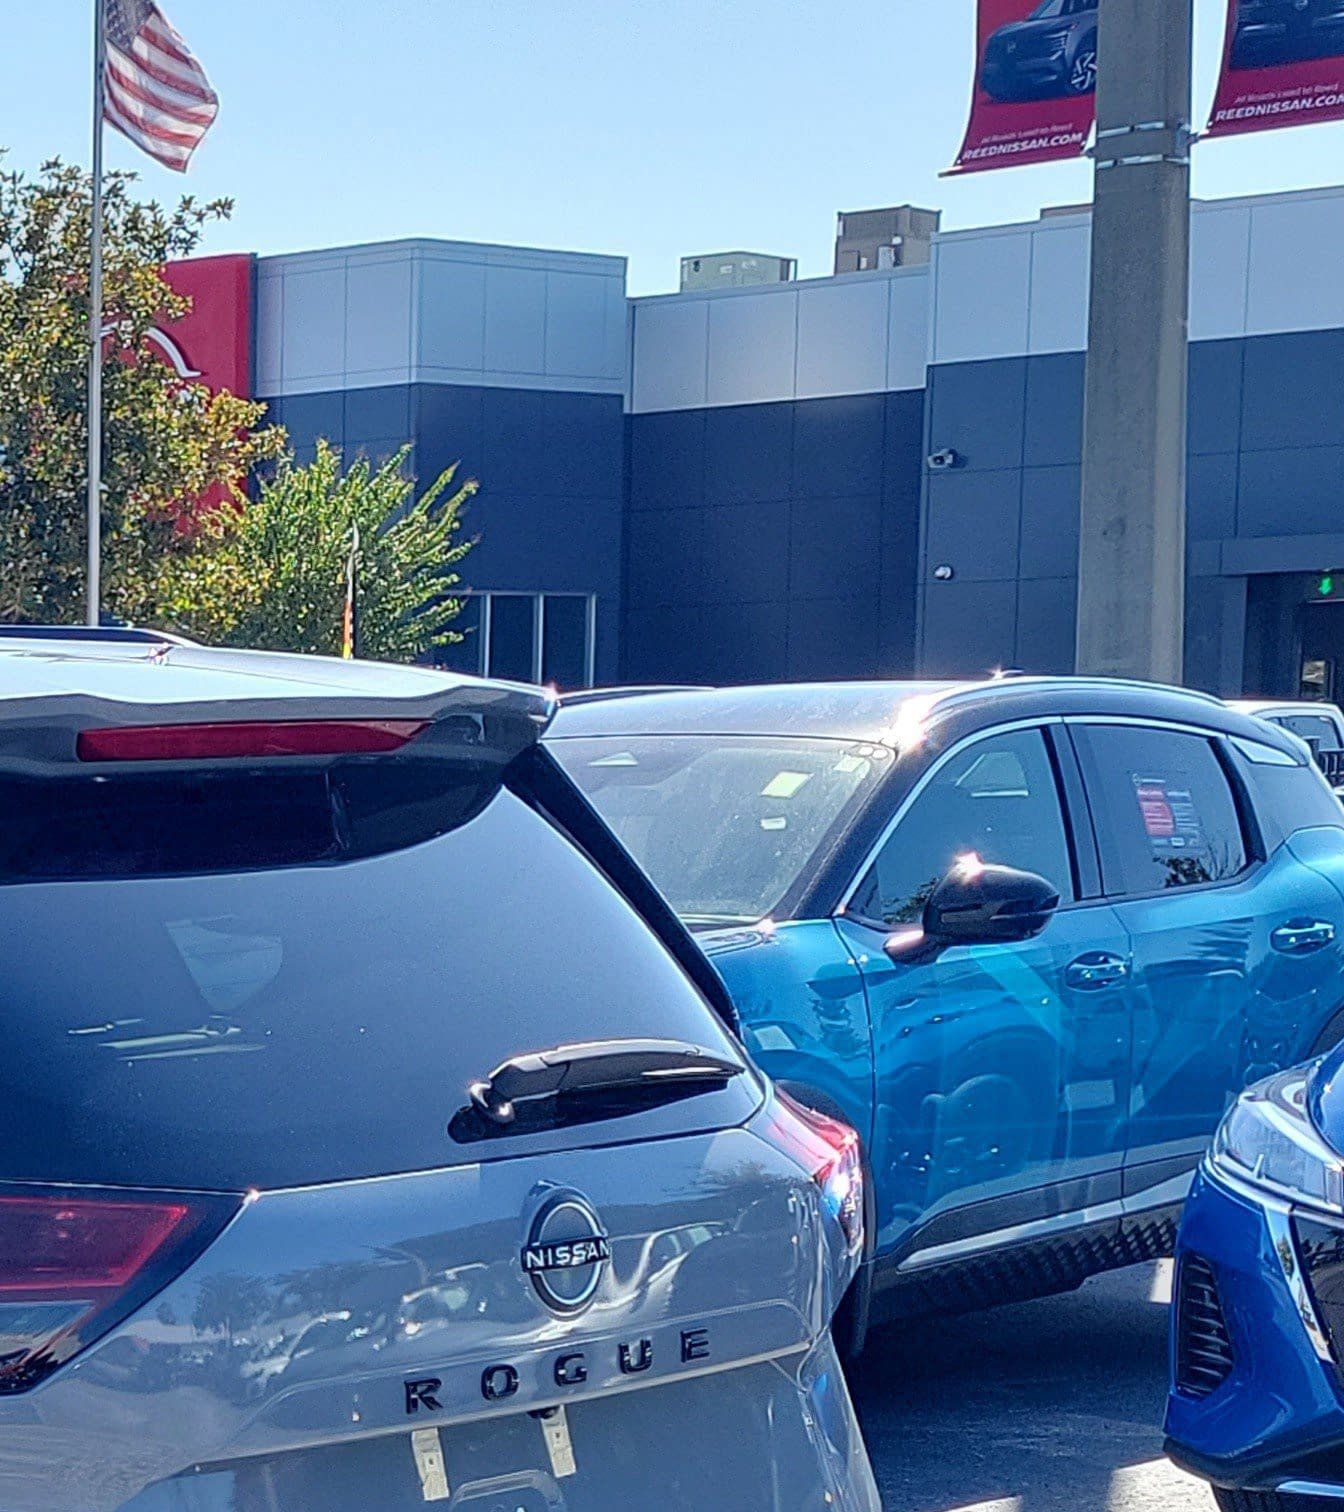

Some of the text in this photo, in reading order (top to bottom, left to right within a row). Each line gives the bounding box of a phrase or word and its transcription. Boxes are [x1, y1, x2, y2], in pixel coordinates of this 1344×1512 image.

[962, 131, 1083, 160] REEDNISSAN.COM
[526, 1239, 610, 1269] NISSAN
[403, 1329, 710, 1414] ROGUE
